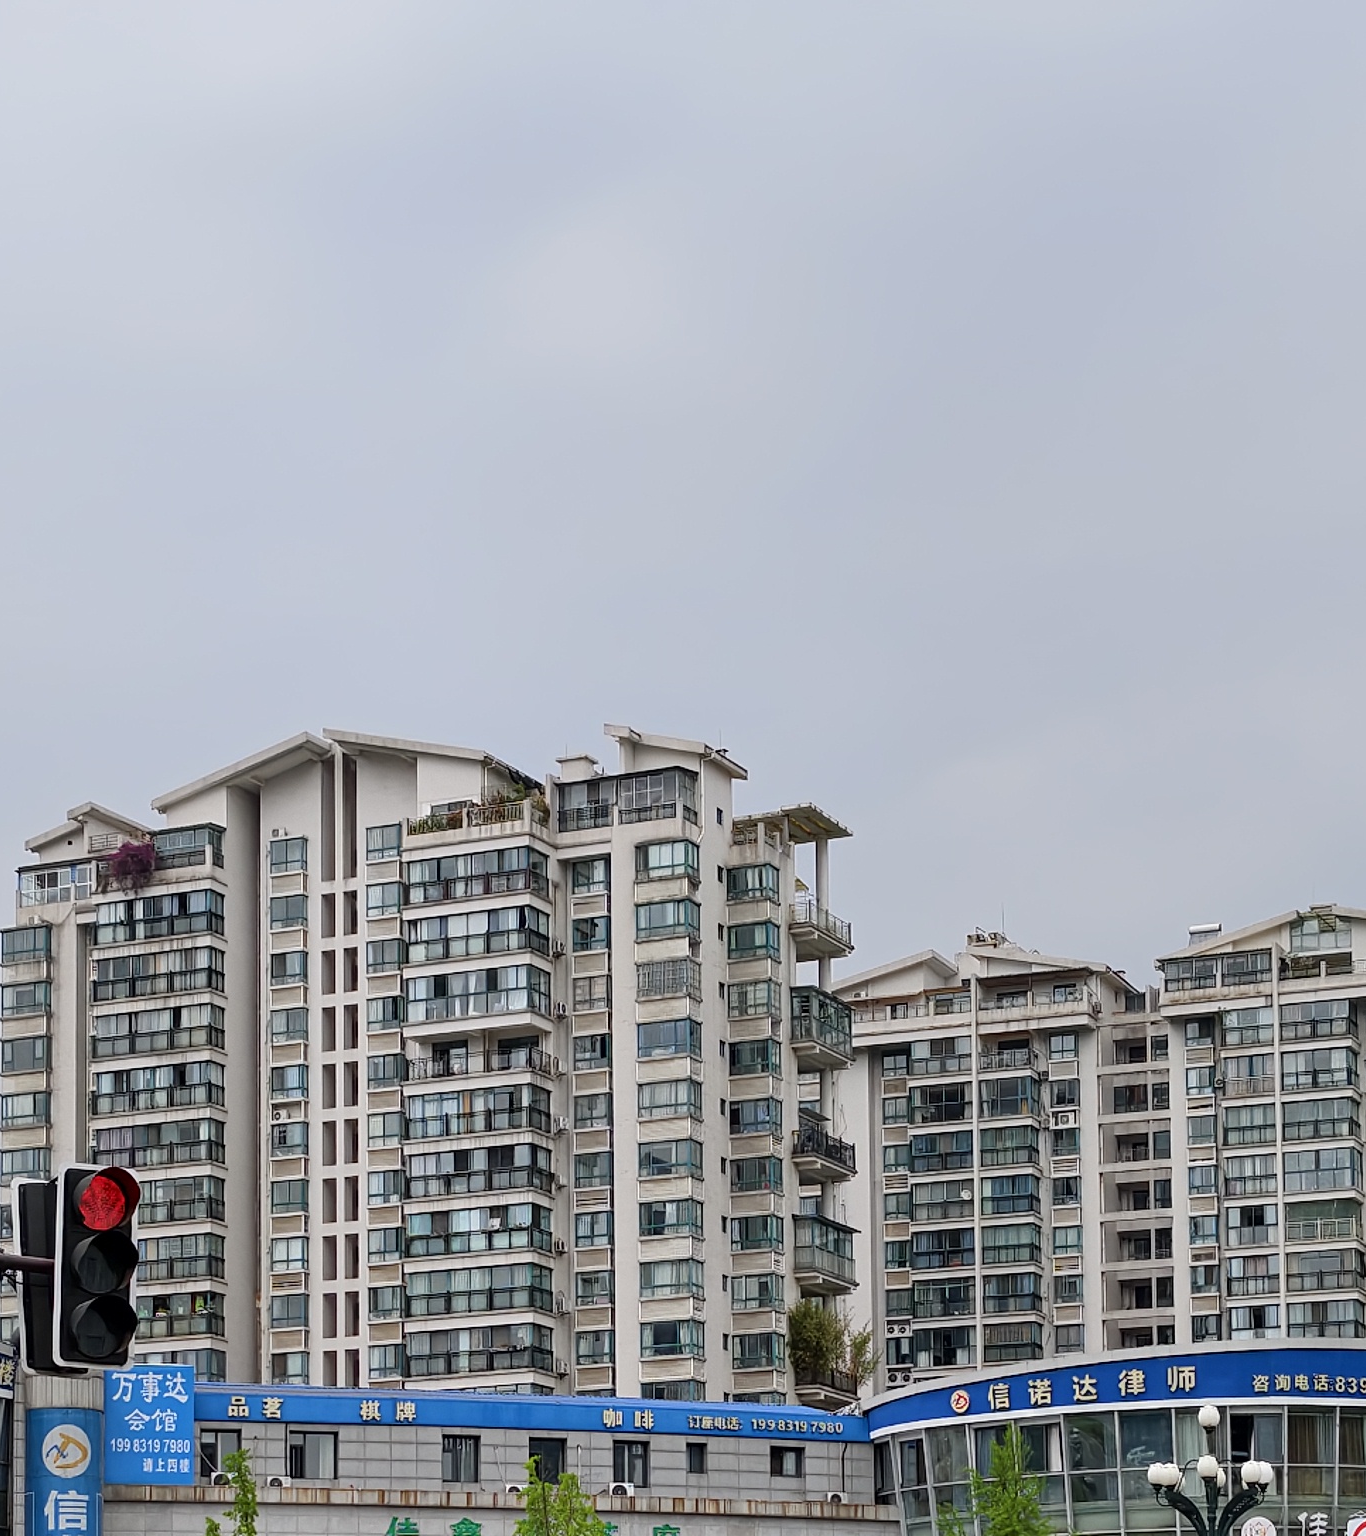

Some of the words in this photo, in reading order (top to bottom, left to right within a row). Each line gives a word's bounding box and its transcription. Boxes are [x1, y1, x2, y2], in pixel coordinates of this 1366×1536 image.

[111, 1371, 190, 1403] 万事达
[988, 1366, 1196, 1410] 信诺达律师
[124, 1408, 178, 1432] 会馆
[227, 1396, 283, 1419] 品茗
[360, 1400, 416, 1422] 棋牌
[603, 1408, 655, 1431] 咖啡
